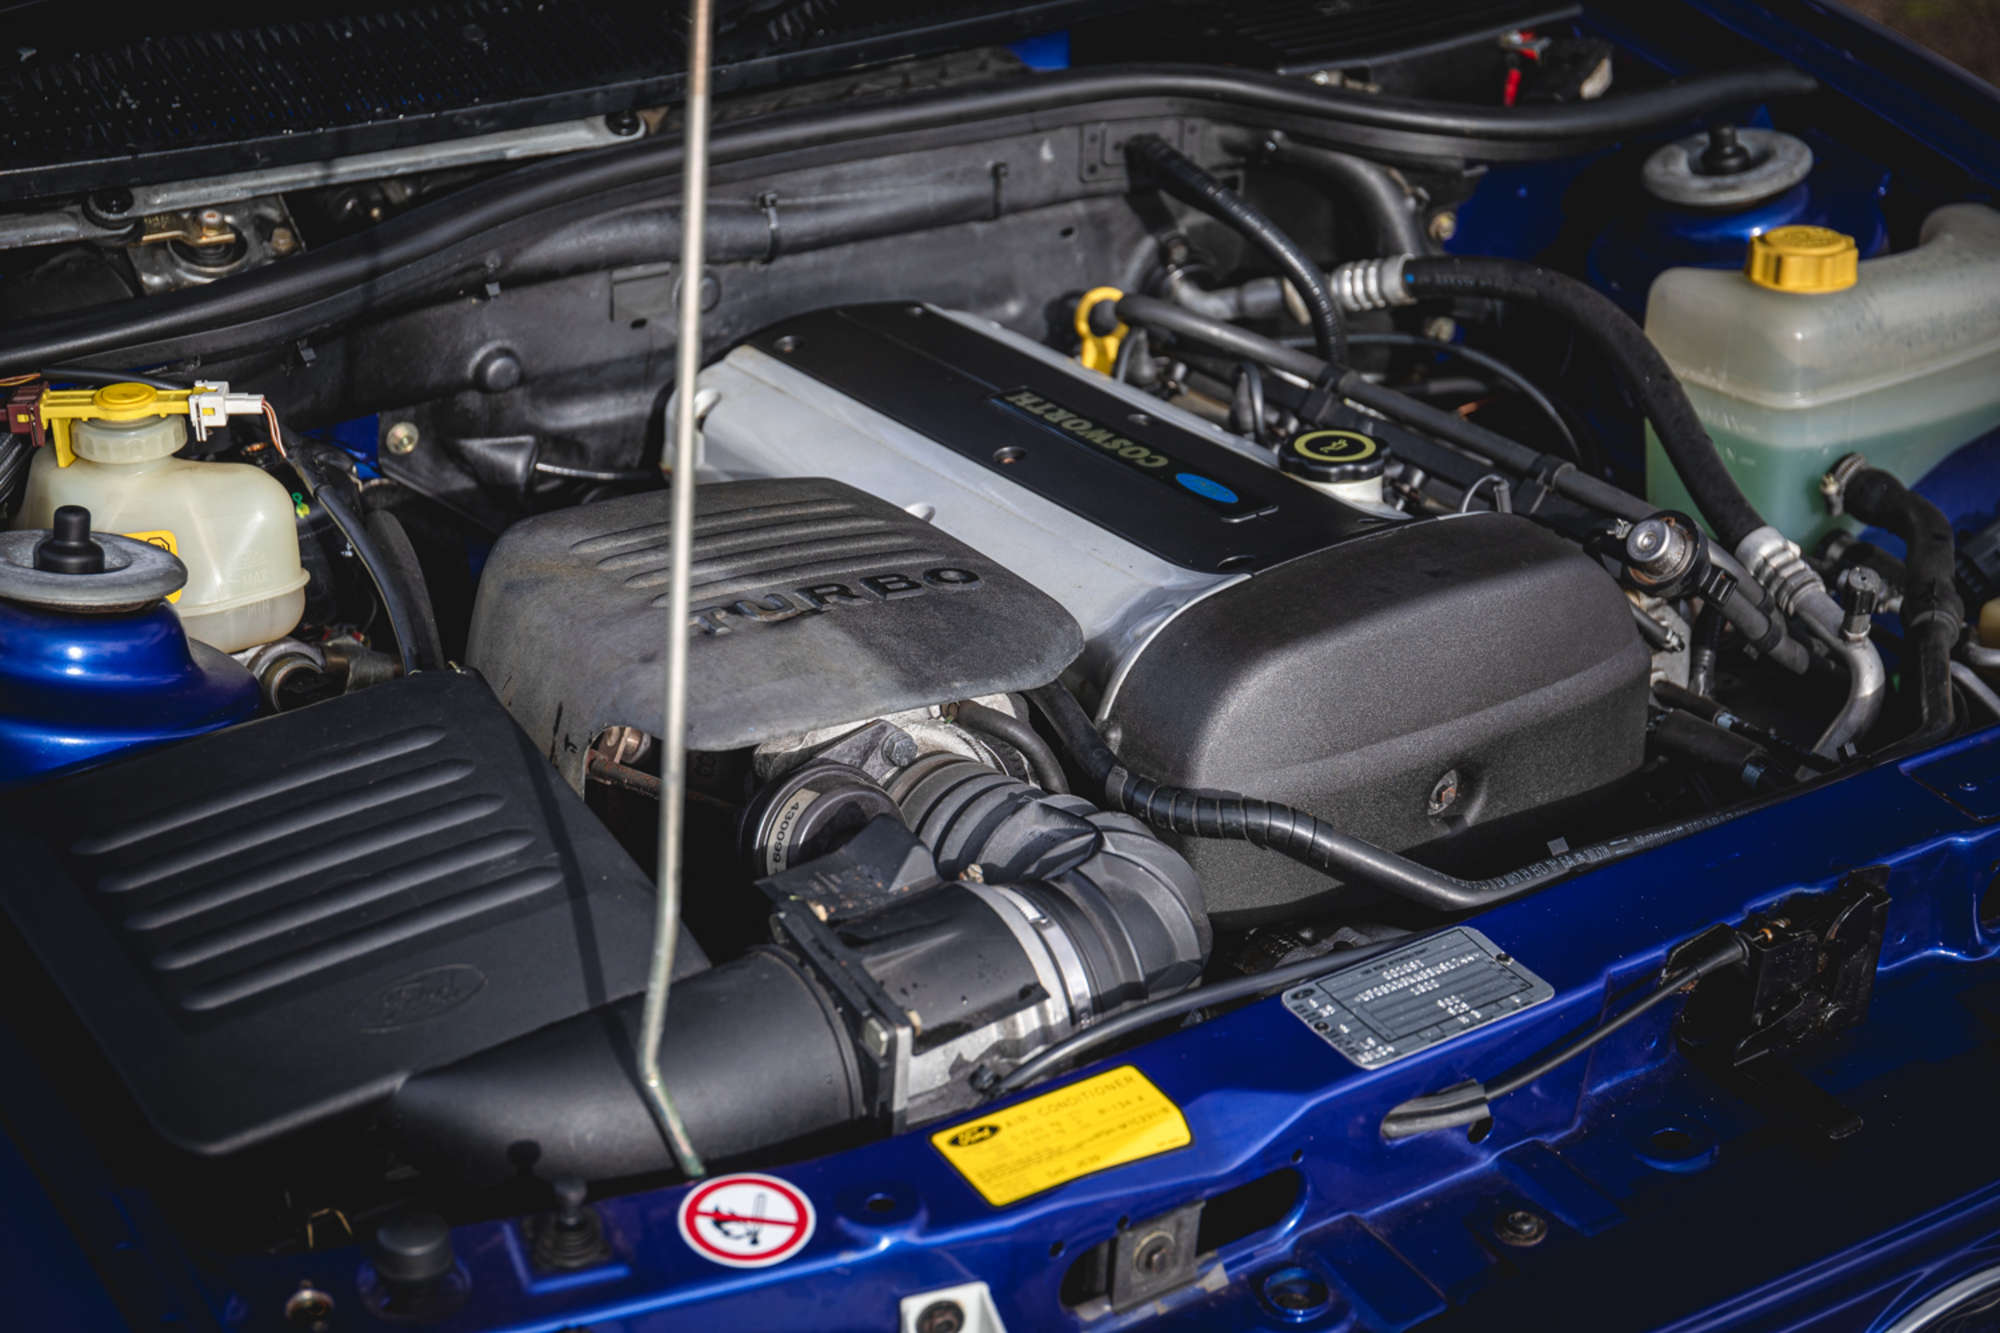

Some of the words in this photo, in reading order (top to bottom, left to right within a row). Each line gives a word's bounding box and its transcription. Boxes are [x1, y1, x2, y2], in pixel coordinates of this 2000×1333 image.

[1006, 391, 1169, 469] COSWORTH
[688, 567, 980, 634] TURBO
[1037, 1075, 1134, 1116] CONDITIONER
